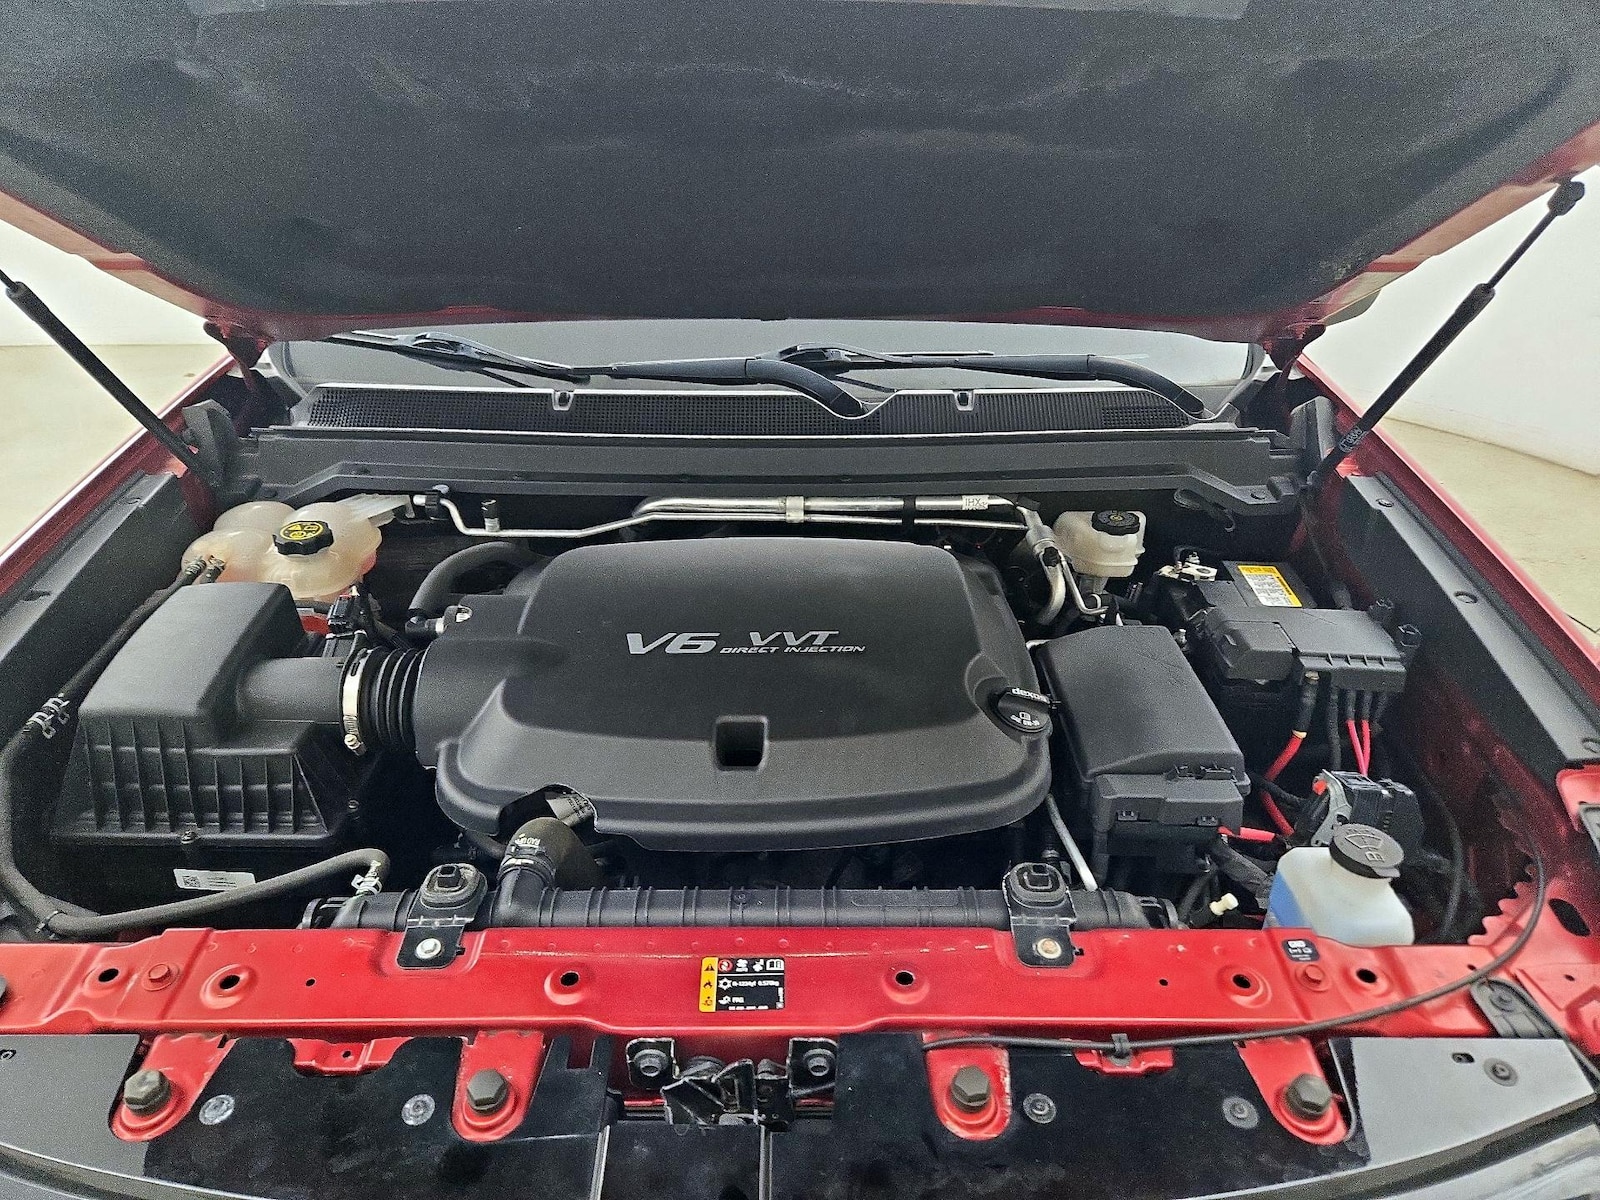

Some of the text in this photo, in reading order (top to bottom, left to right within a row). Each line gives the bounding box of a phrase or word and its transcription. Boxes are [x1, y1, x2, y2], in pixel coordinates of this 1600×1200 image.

[626, 630, 840, 655] V6 VVT
[719, 645, 866, 654] DIRECT INJECTION
